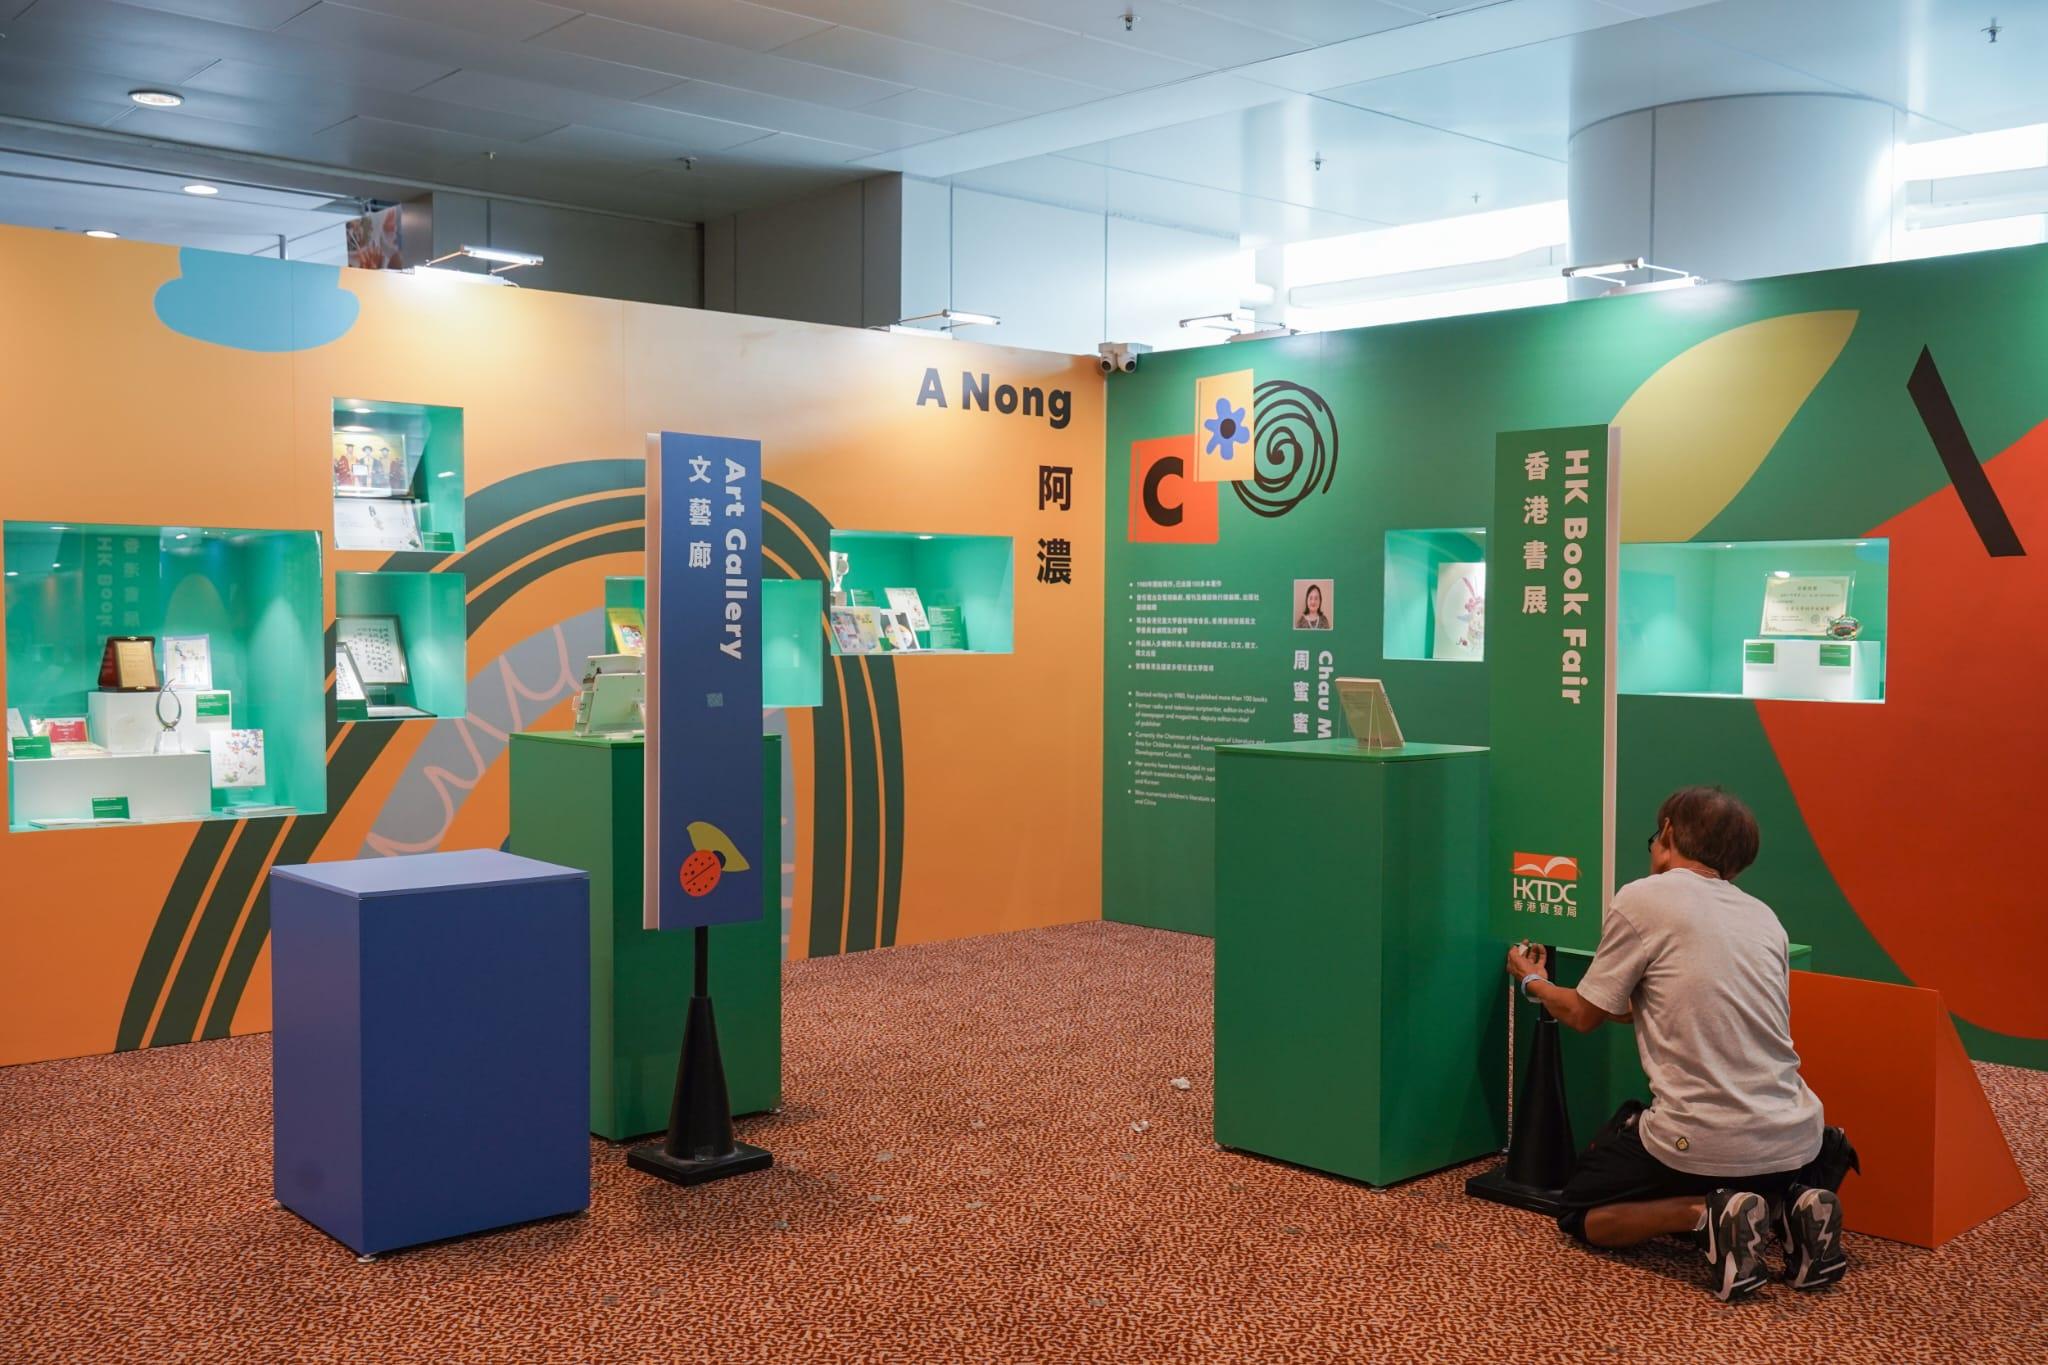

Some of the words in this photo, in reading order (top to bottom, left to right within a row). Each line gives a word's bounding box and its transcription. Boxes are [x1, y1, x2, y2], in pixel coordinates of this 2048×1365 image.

[916, 367, 947, 408] A
[962, 371, 1071, 429] Nong
[724, 457, 747, 517] Art
[1143, 456, 1184, 527] C
[1564, 449, 1590, 505] HK
[688, 455, 711, 569] 文藝廊
[1037, 465, 1073, 585] 阿濃
[1522, 450, 1550, 614] 香港書展
[719, 528, 748, 660] Gallery
[1563, 517, 1589, 616] Book
[1195, 693, 1218, 702] published
[1293, 649, 1310, 734] 周蜜蜜
[1318, 650, 1334, 711] Chau
[1562, 628, 1588, 704] Fair
[1200, 735, 1226, 743] Federation
[1513, 877, 1577, 906] HKTDC
[1513, 900, 1577, 918] 香港貿發局
